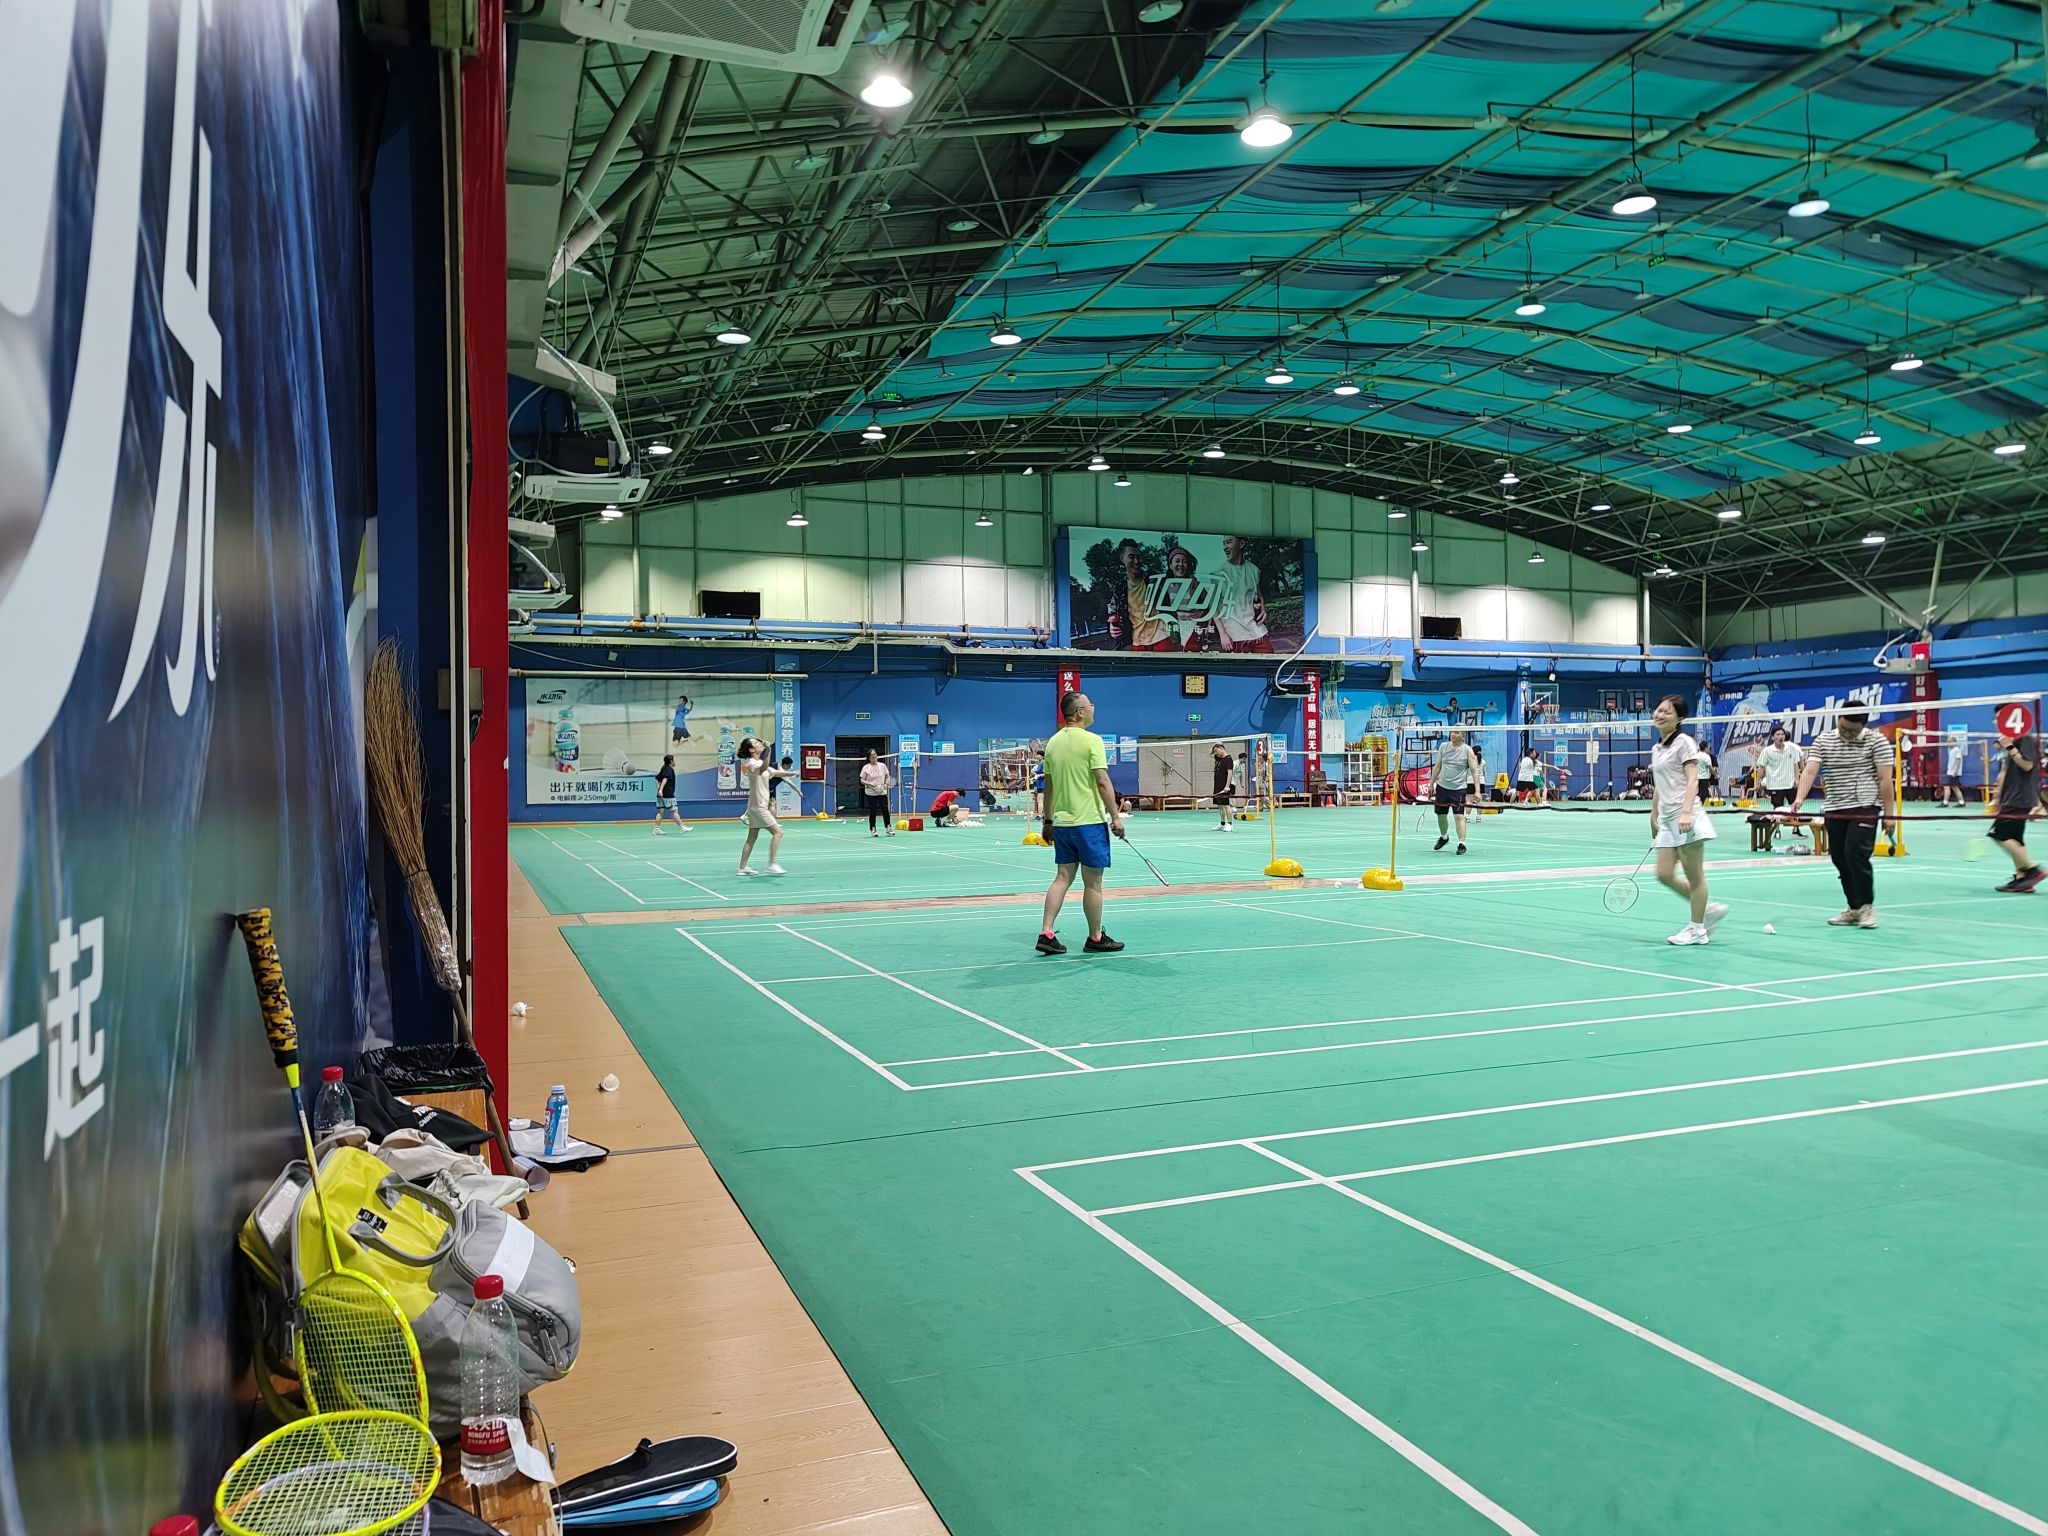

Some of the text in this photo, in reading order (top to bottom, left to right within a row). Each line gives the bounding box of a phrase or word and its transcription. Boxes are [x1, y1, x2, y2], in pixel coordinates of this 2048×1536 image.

[1144, 572, 1234, 623] 可口可乐
[2005, 707, 2025, 734] 4
[1256, 741, 1264, 755] 3
[549, 781, 645, 793] 出汗就喝「水动乐」
